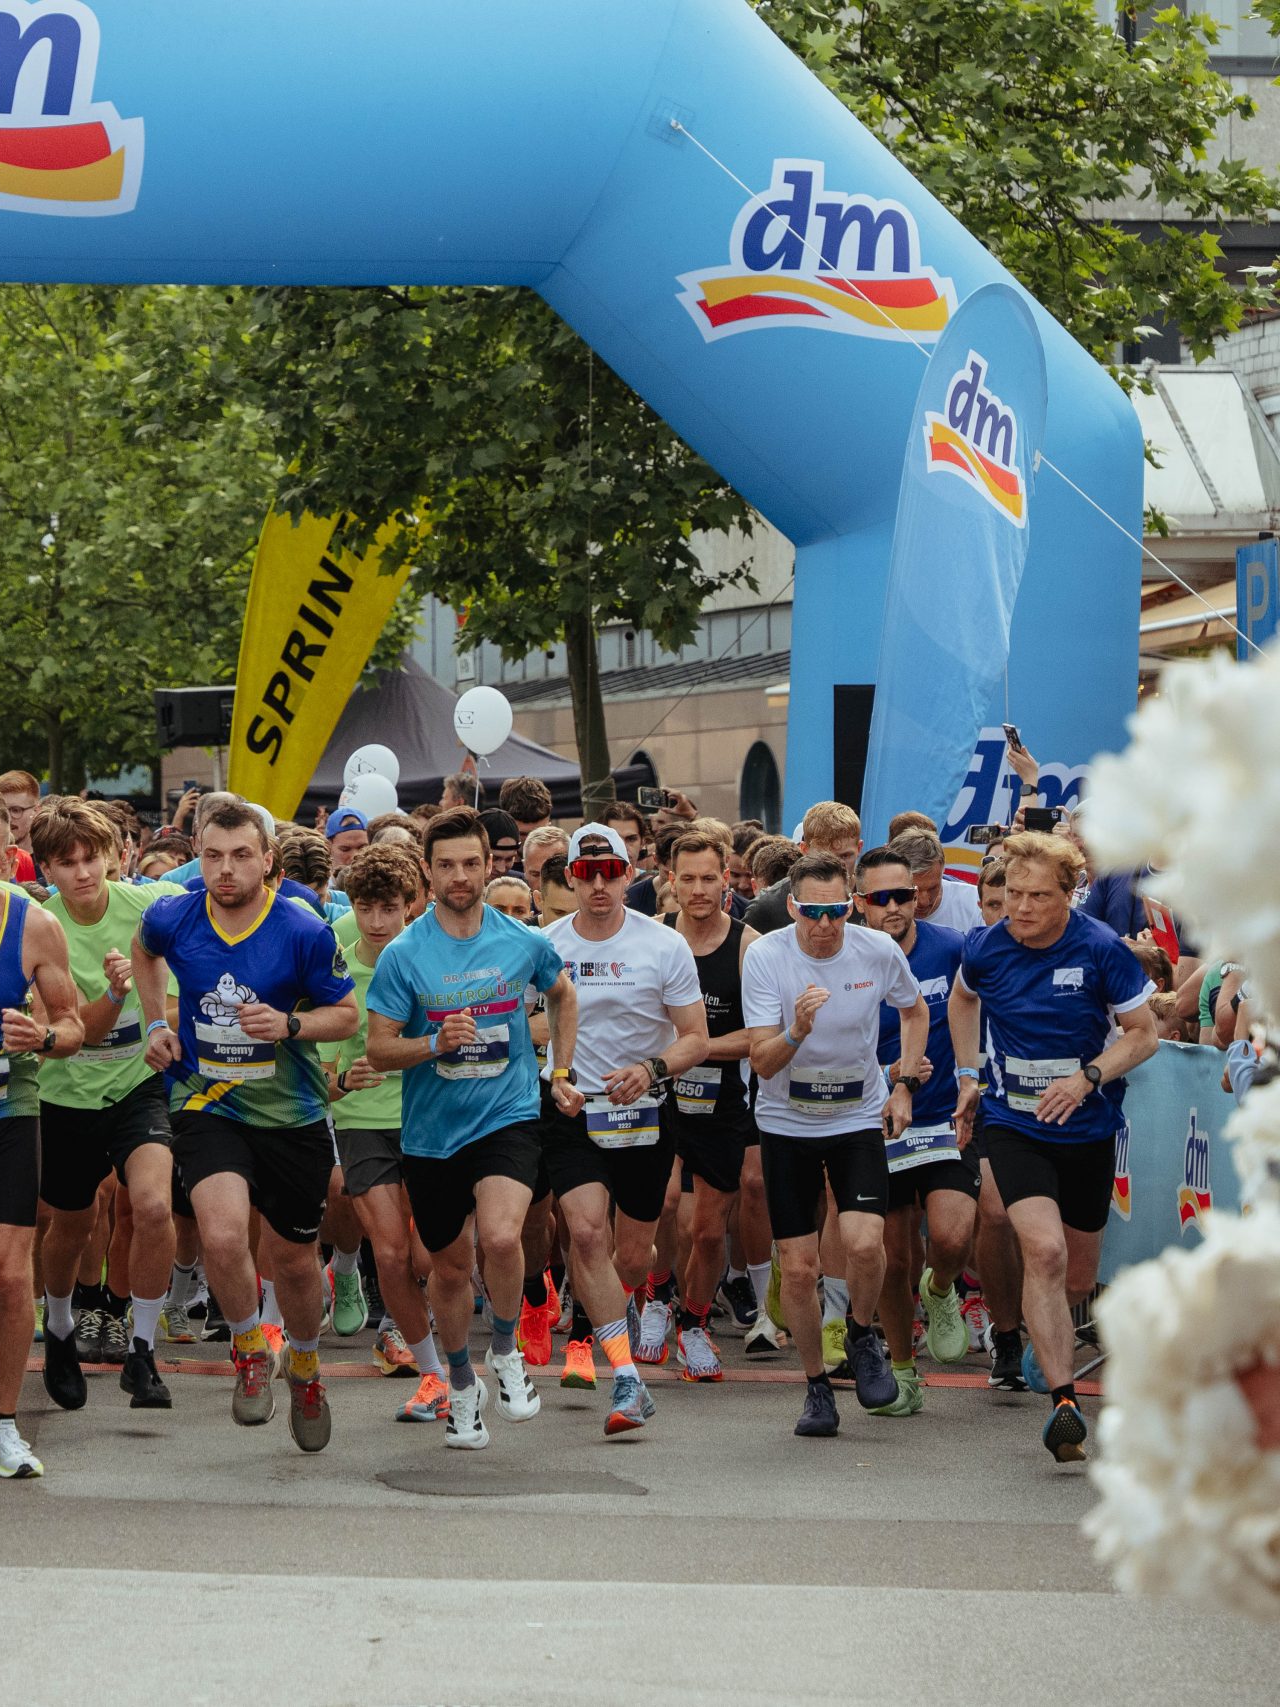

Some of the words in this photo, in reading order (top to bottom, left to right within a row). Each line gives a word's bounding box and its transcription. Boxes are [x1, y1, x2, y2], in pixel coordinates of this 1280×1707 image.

[743, 170, 910, 272] dm
[949, 361, 1013, 467] dm
[1246, 561, 1269, 660] P
[854, 980, 874, 989] BOSCH
[104, 1031, 119, 1040] as
[213, 1044, 254, 1056] Jeremy
[458, 1044, 488, 1055] Jonas
[1019, 1076, 1056, 1087] Matthi
[810, 1083, 844, 1093] Stefan
[608, 1110, 640, 1122] Martin
[906, 1136, 935, 1147] Oliver
[1185, 1116, 1209, 1189] dm
